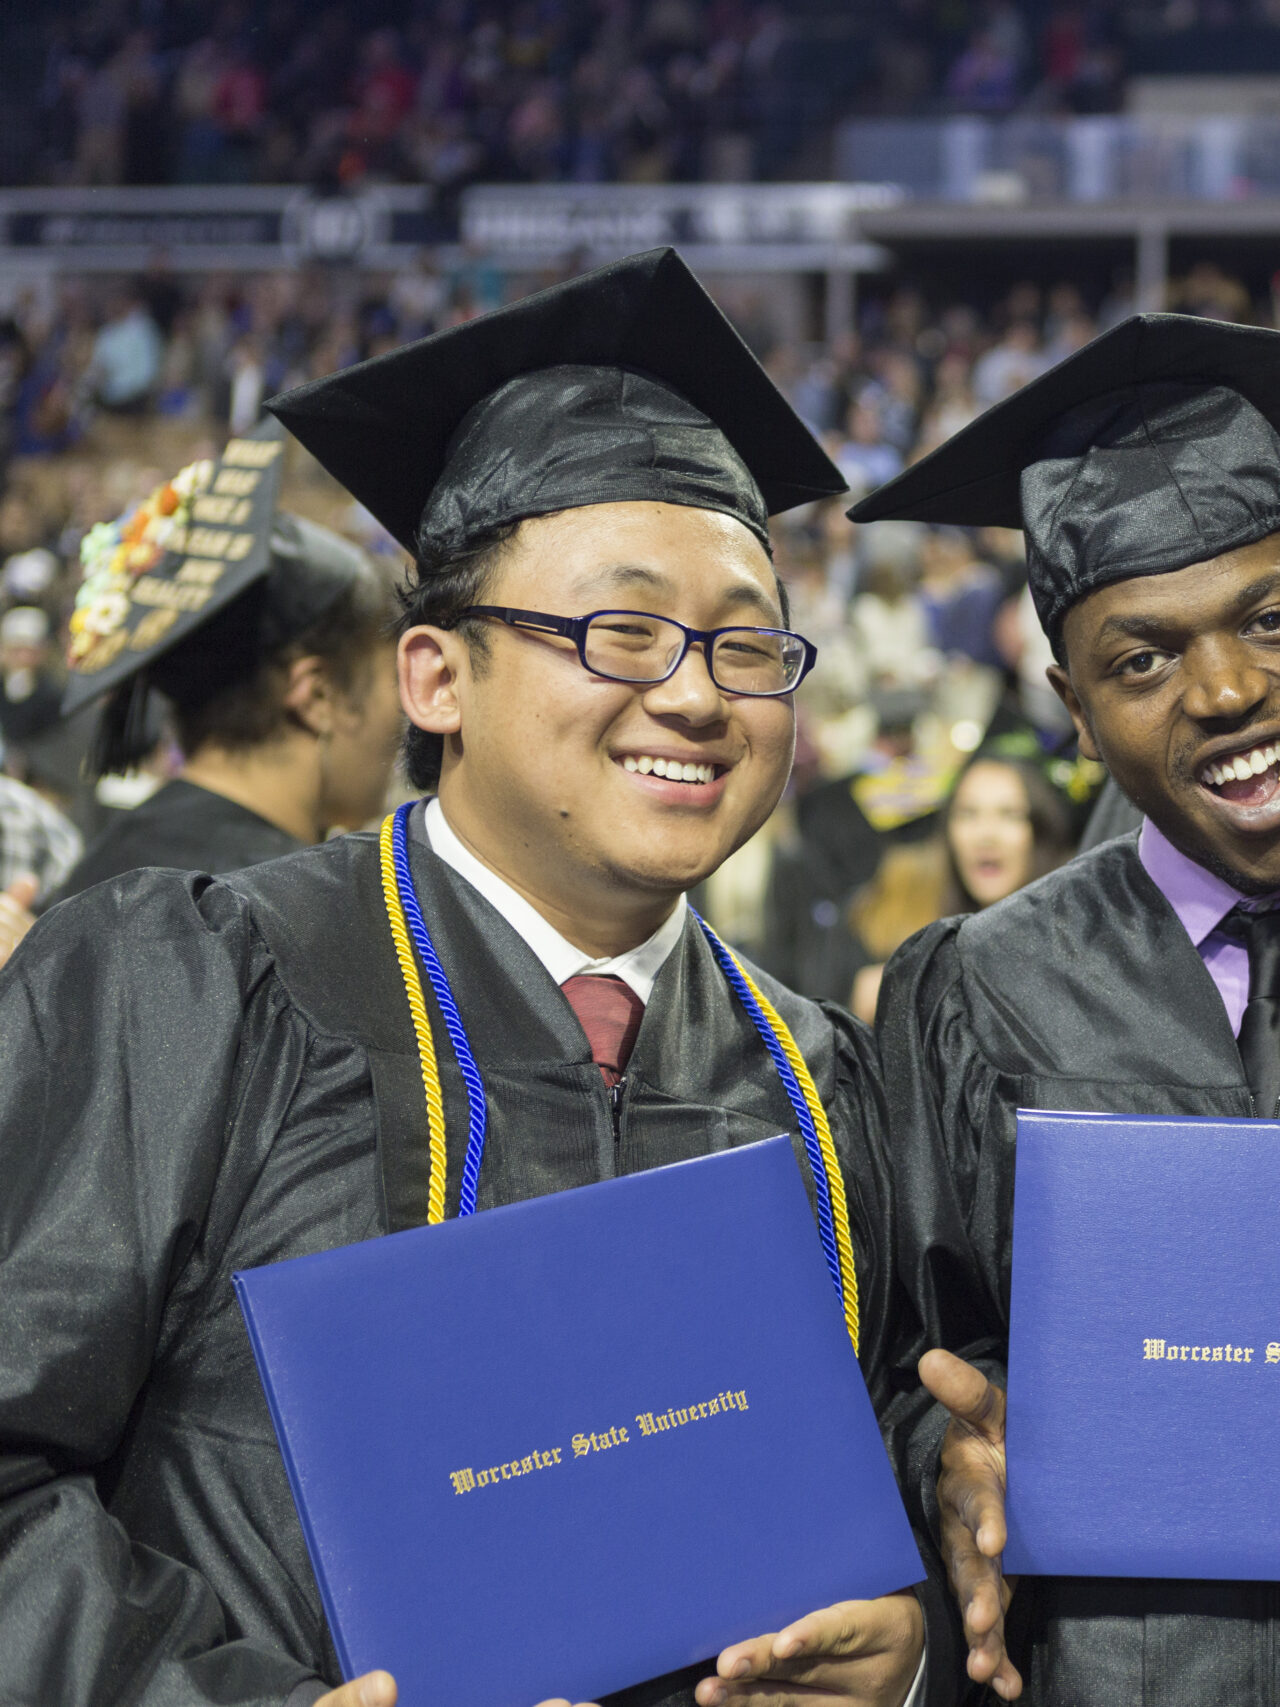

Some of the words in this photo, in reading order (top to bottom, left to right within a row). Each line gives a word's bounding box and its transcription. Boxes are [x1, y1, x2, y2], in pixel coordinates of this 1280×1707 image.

[1143, 1338, 1254, 1363] Worcester
[449, 1447, 562, 1495] Worcester
[571, 1426, 630, 1459] State
[635, 1390, 749, 1437] University
